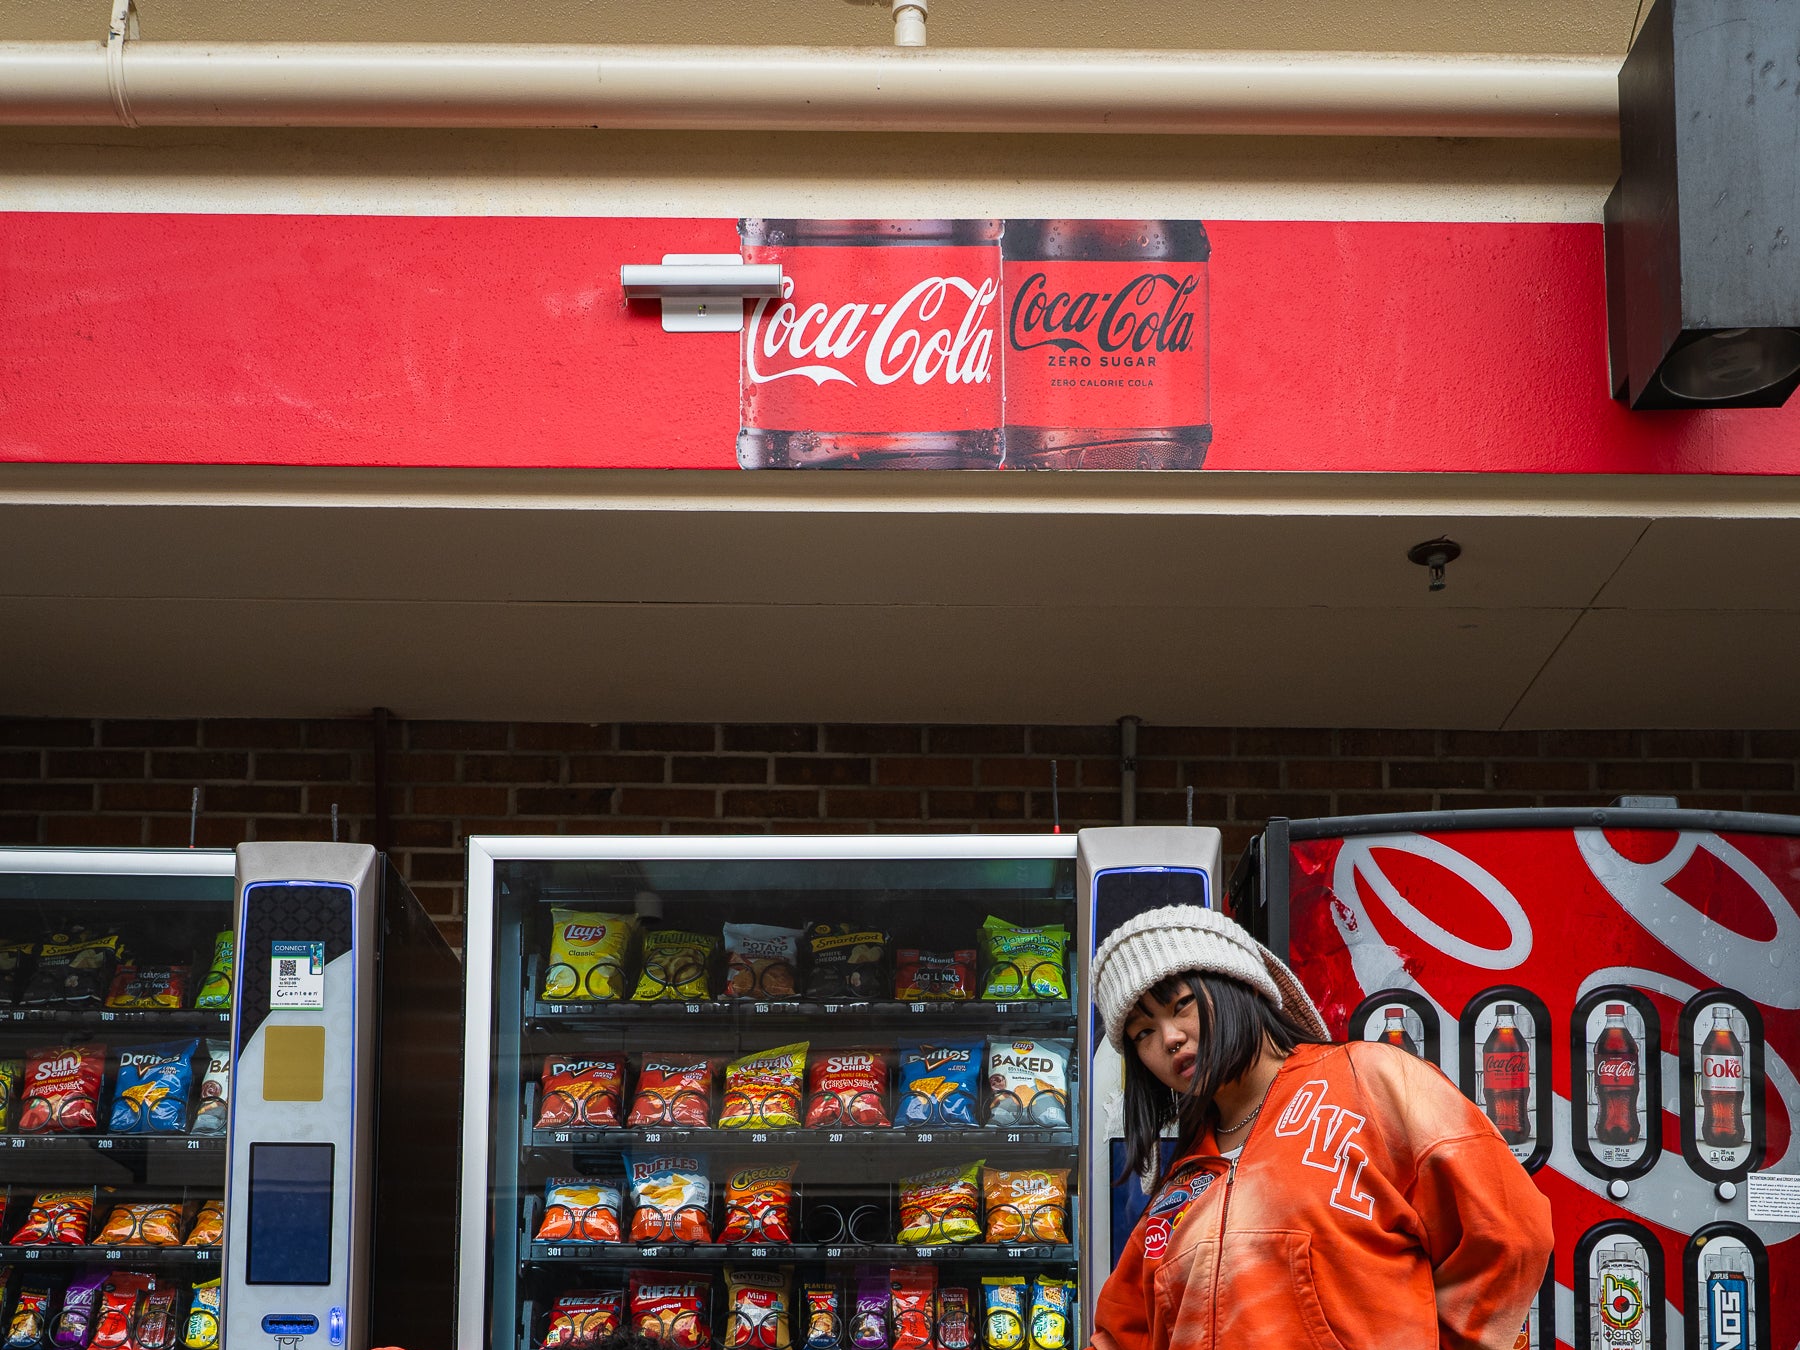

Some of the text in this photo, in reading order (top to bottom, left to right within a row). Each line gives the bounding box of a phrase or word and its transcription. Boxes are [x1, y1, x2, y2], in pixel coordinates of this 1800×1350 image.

[1009, 272, 1200, 353] Coca-Cola
[749, 275, 993, 387] Coca-Cola
[1047, 355, 1157, 368] ZERO SUGAR
[1050, 379, 1154, 388] ZERO CALORIE COLA
[566, 925, 605, 941] Lay's
[816, 933, 879, 949] Smartfood
[742, 941, 789, 951] POTATO
[815, 955, 847, 964] CHEDDAR
[550, 1005, 563, 1013] 101
[686, 1004, 700, 1013] 103
[755, 1004, 769, 1013] 105
[826, 1004, 838, 1013] 107
[911, 1004, 925, 1013] 109
[996, 1004, 1008, 1013] 111
[13, 1012, 25, 1020] 107
[101, 1012, 115, 1021] 109
[219, 1013, 230, 1021] 111
[120, 1052, 181, 1067] Doritos
[826, 1054, 873, 1073] Sun
[991, 1054, 1054, 1073] BAKED
[1485, 1054, 1528, 1073] Coca-Cola
[34, 1056, 81, 1080] Sun
[552, 1060, 617, 1076] Doritos
[645, 1060, 707, 1074] Doritos
[842, 1064, 872, 1072] CHIPS
[1597, 1060, 1636, 1077] Coca-Cola
[1703, 1057, 1742, 1078] Coke
[50, 1068, 79, 1077] CHIPS
[555, 1134, 569, 1142] 201
[646, 1134, 660, 1142] 203
[752, 1134, 767, 1142] 205
[829, 1134, 843, 1142] 207
[918, 1134, 932, 1142] 209
[1007, 1134, 1020, 1142] 211
[12, 1140, 25, 1148] 207
[98, 1140, 113, 1148] 209
[187, 1140, 199, 1149] 211
[1274, 1079, 1375, 1221] OVL
[634, 1157, 699, 1180] RUFFLES
[731, 1167, 791, 1191] Cheetos
[1193, 1176, 1212, 1186] ROUTE
[1010, 1179, 1051, 1198] Sun
[1145, 1233, 1165, 1244] OVL
[25, 1251, 40, 1259] 307
[106, 1251, 121, 1259] 309
[196, 1251, 209, 1259] 311
[547, 1248, 561, 1256] 301
[642, 1248, 657, 1256] 303
[752, 1249, 767, 1257] 305
[827, 1249, 841, 1257] 307
[917, 1249, 932, 1257] 309
[1008, 1249, 1021, 1257] 311
[639, 1285, 697, 1300] CHEEZ-IT
[747, 1291, 767, 1300] Mini
[559, 1296, 616, 1307] CHEEZ-IT
[1603, 1325, 1642, 1344] bang
